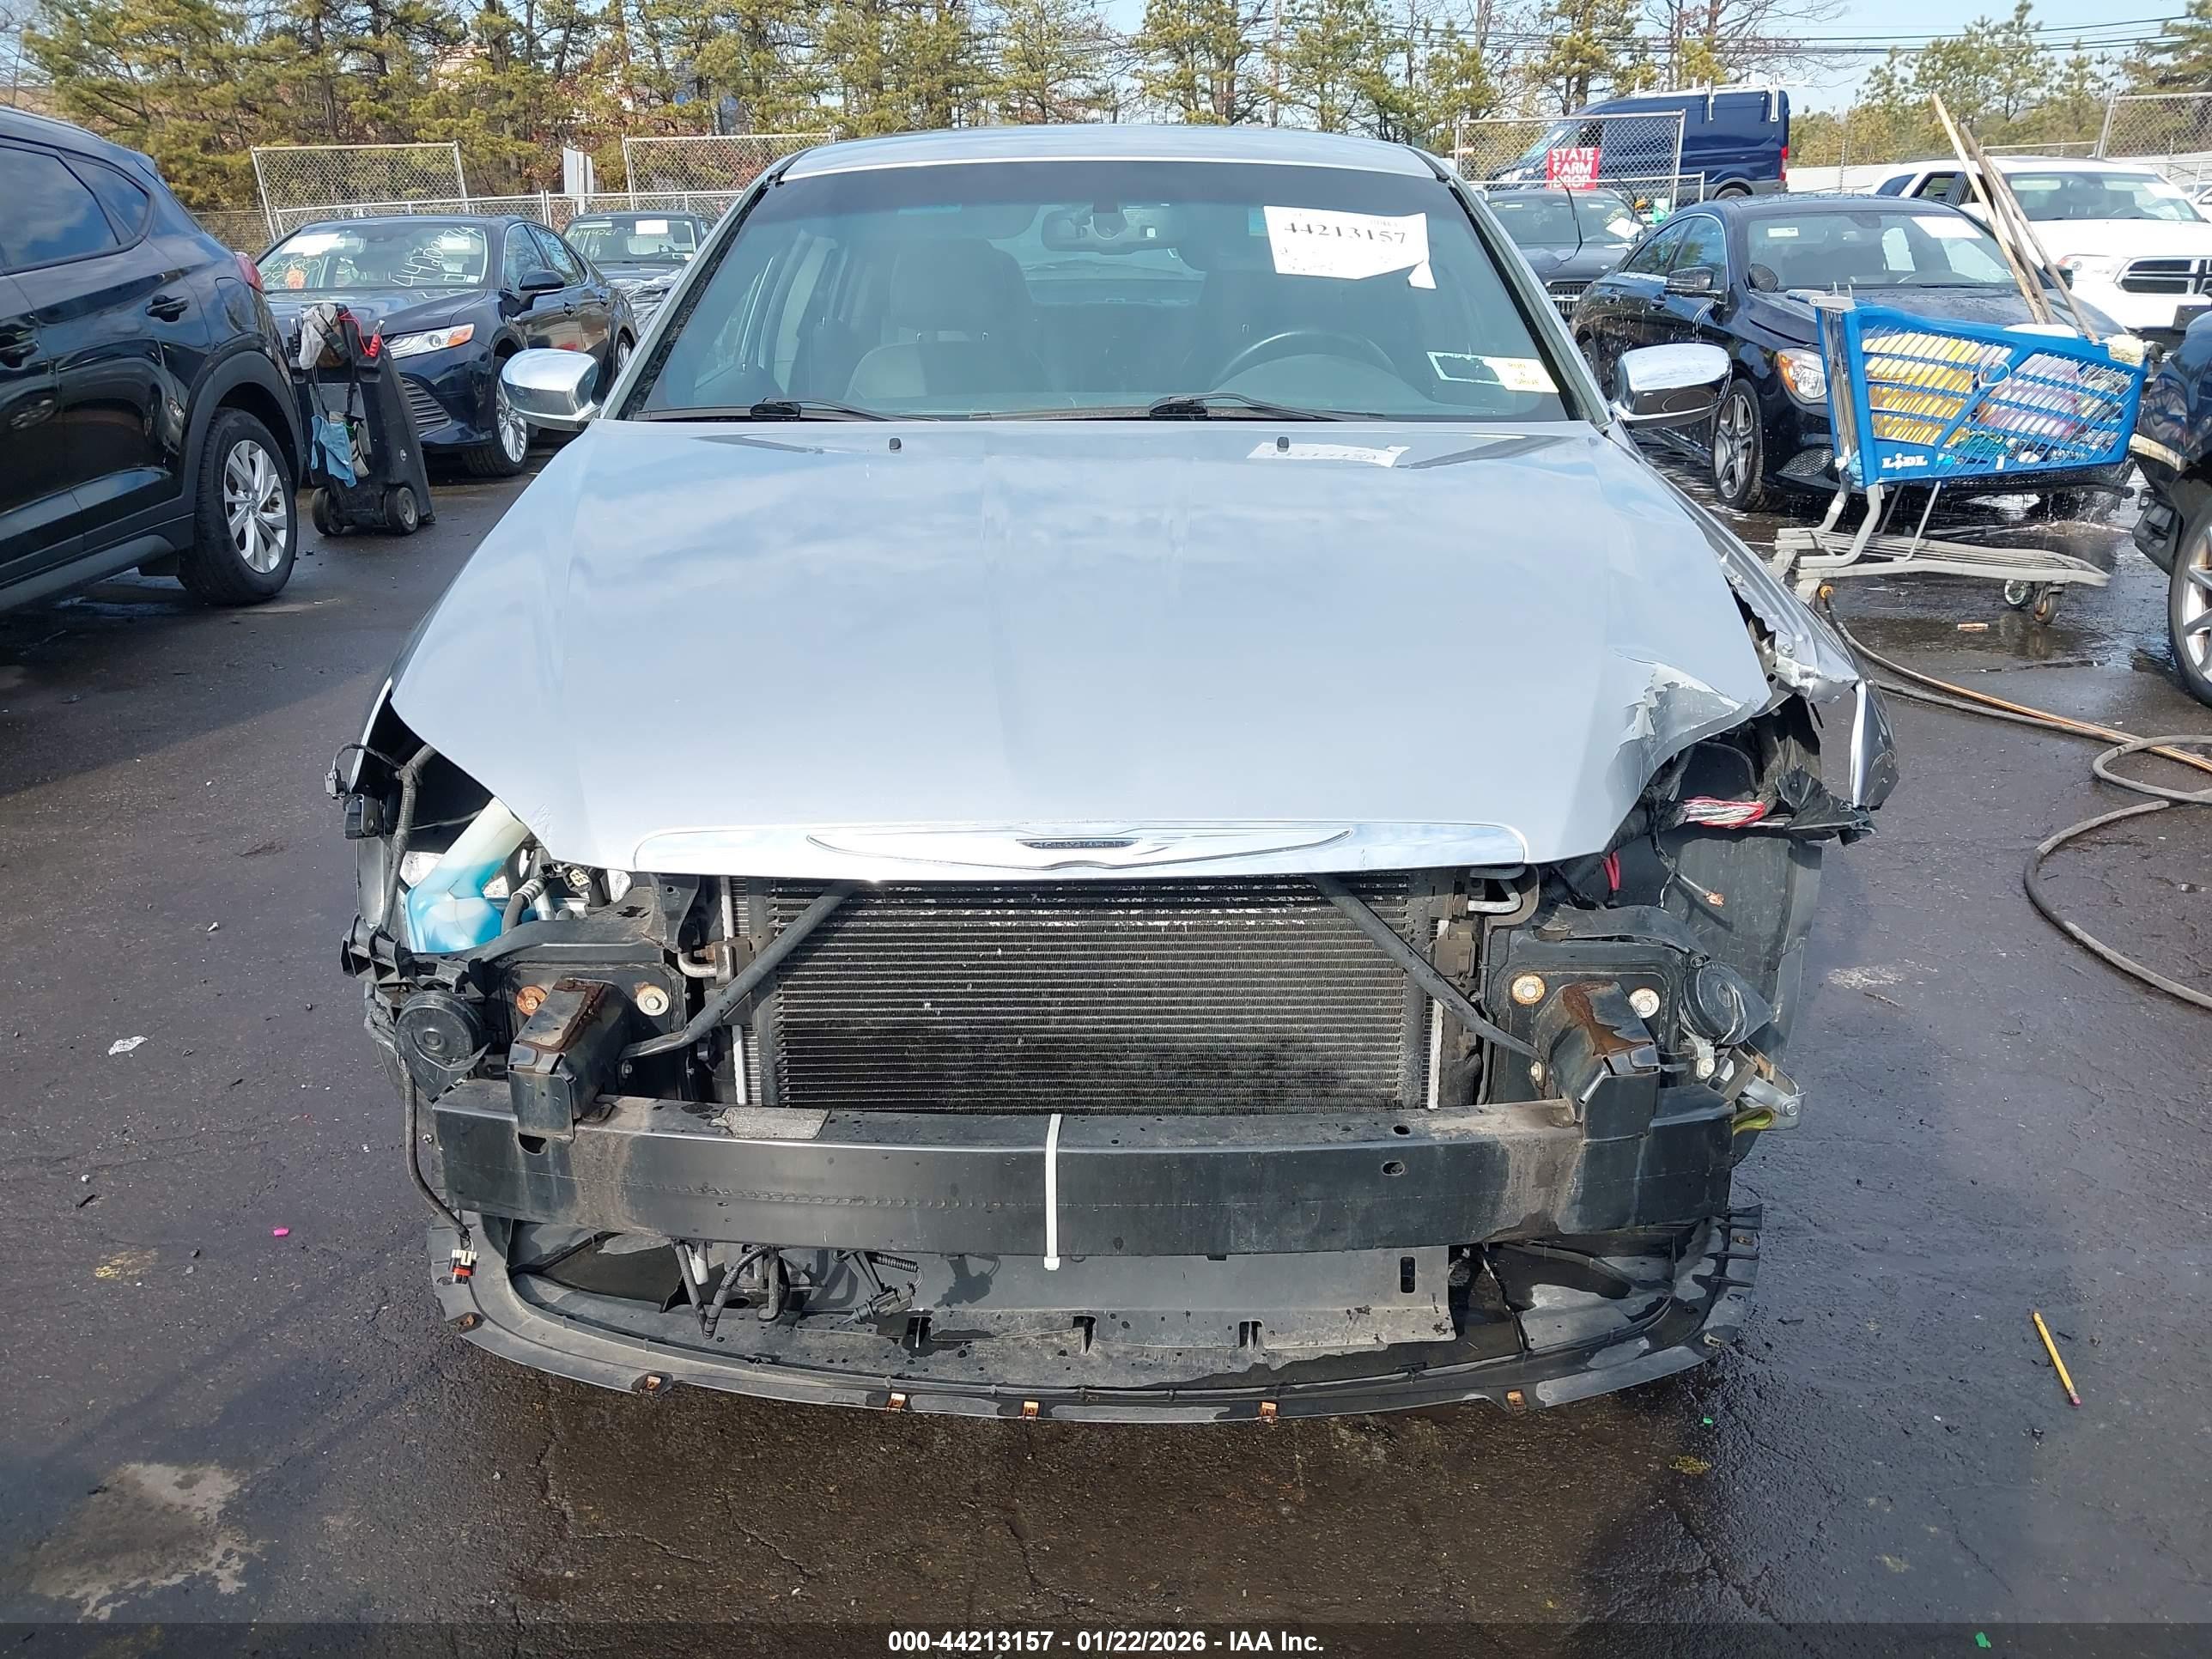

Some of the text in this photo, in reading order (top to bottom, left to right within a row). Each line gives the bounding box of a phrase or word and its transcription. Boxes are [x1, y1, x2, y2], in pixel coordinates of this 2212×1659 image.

[1552, 148, 1595, 161] STATE
[1553, 161, 1593, 174] FARM
[1552, 174, 1591, 188] DROP
[1284, 222, 1407, 244] 44213157
